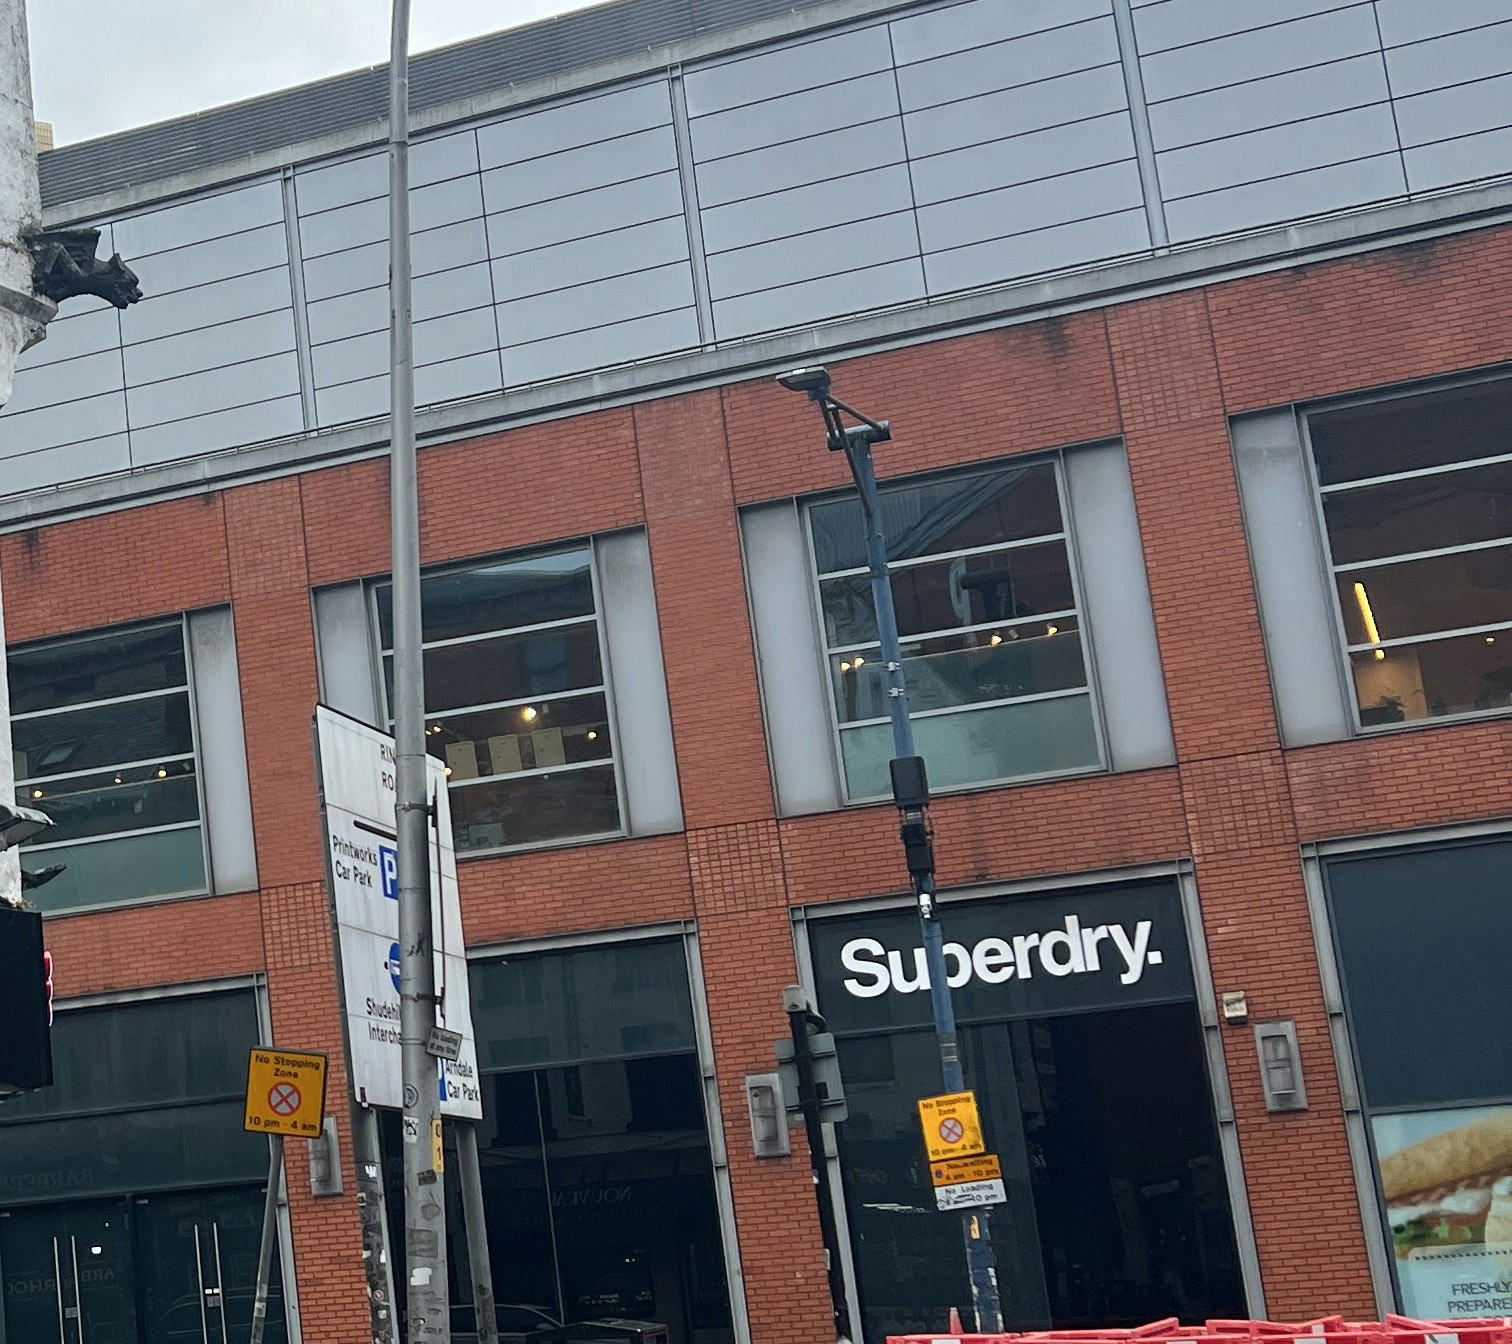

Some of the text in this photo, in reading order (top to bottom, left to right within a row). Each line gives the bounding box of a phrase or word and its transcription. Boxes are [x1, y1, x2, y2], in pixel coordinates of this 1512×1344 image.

[380, 743, 396, 765] RIN
[332, 834, 378, 866] Printworks
[336, 860, 373, 888] Car Park
[366, 997, 400, 1021] Shudehi
[368, 1021, 402, 1045] Intercha
[255, 1054, 320, 1071] No Stopping
[445, 1059, 473, 1079] Arndale
[273, 1067, 299, 1079] Zone
[447, 1080, 479, 1102] Car Park
[921, 1096, 970, 1110] No Stopping
[938, 1108, 956, 1116] Zone
[249, 1116, 261, 1126] 10
[263, 1119, 280, 1128] pm
[290, 1120, 298, 1129] 4
[301, 1124, 317, 1132] am
[1452, 1281, 1512, 1296] FRESHLY
